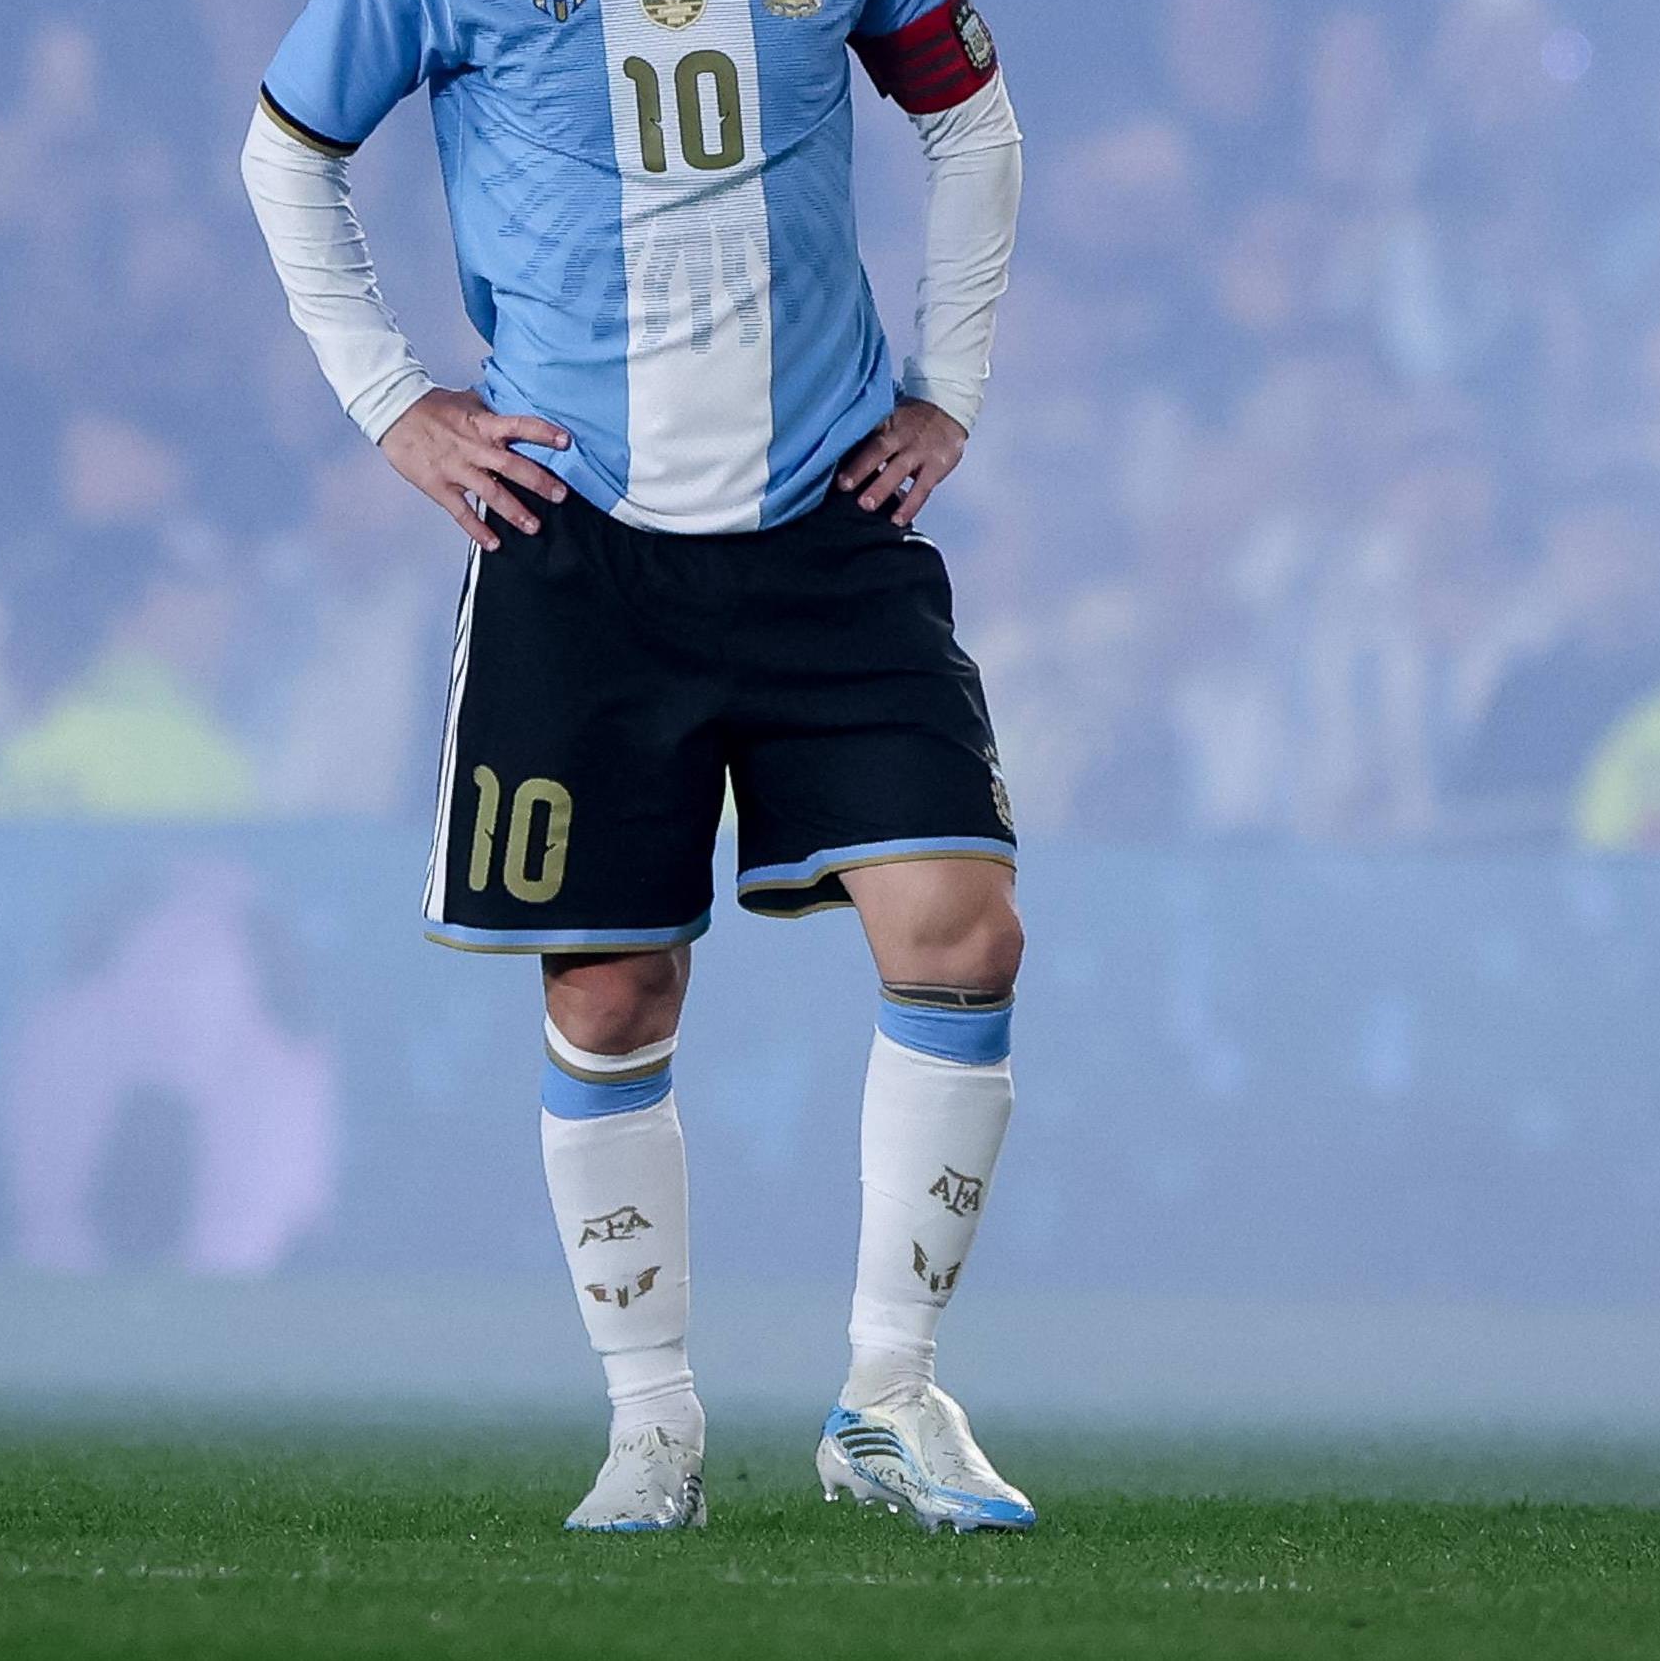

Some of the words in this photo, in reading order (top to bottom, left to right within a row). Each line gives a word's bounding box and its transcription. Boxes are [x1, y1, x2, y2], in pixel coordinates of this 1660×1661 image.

[623, 49, 744, 173] 10
[469, 765, 571, 902] 10
[578, 1206, 654, 1248] AFA
[928, 1166, 984, 1215] AFA
